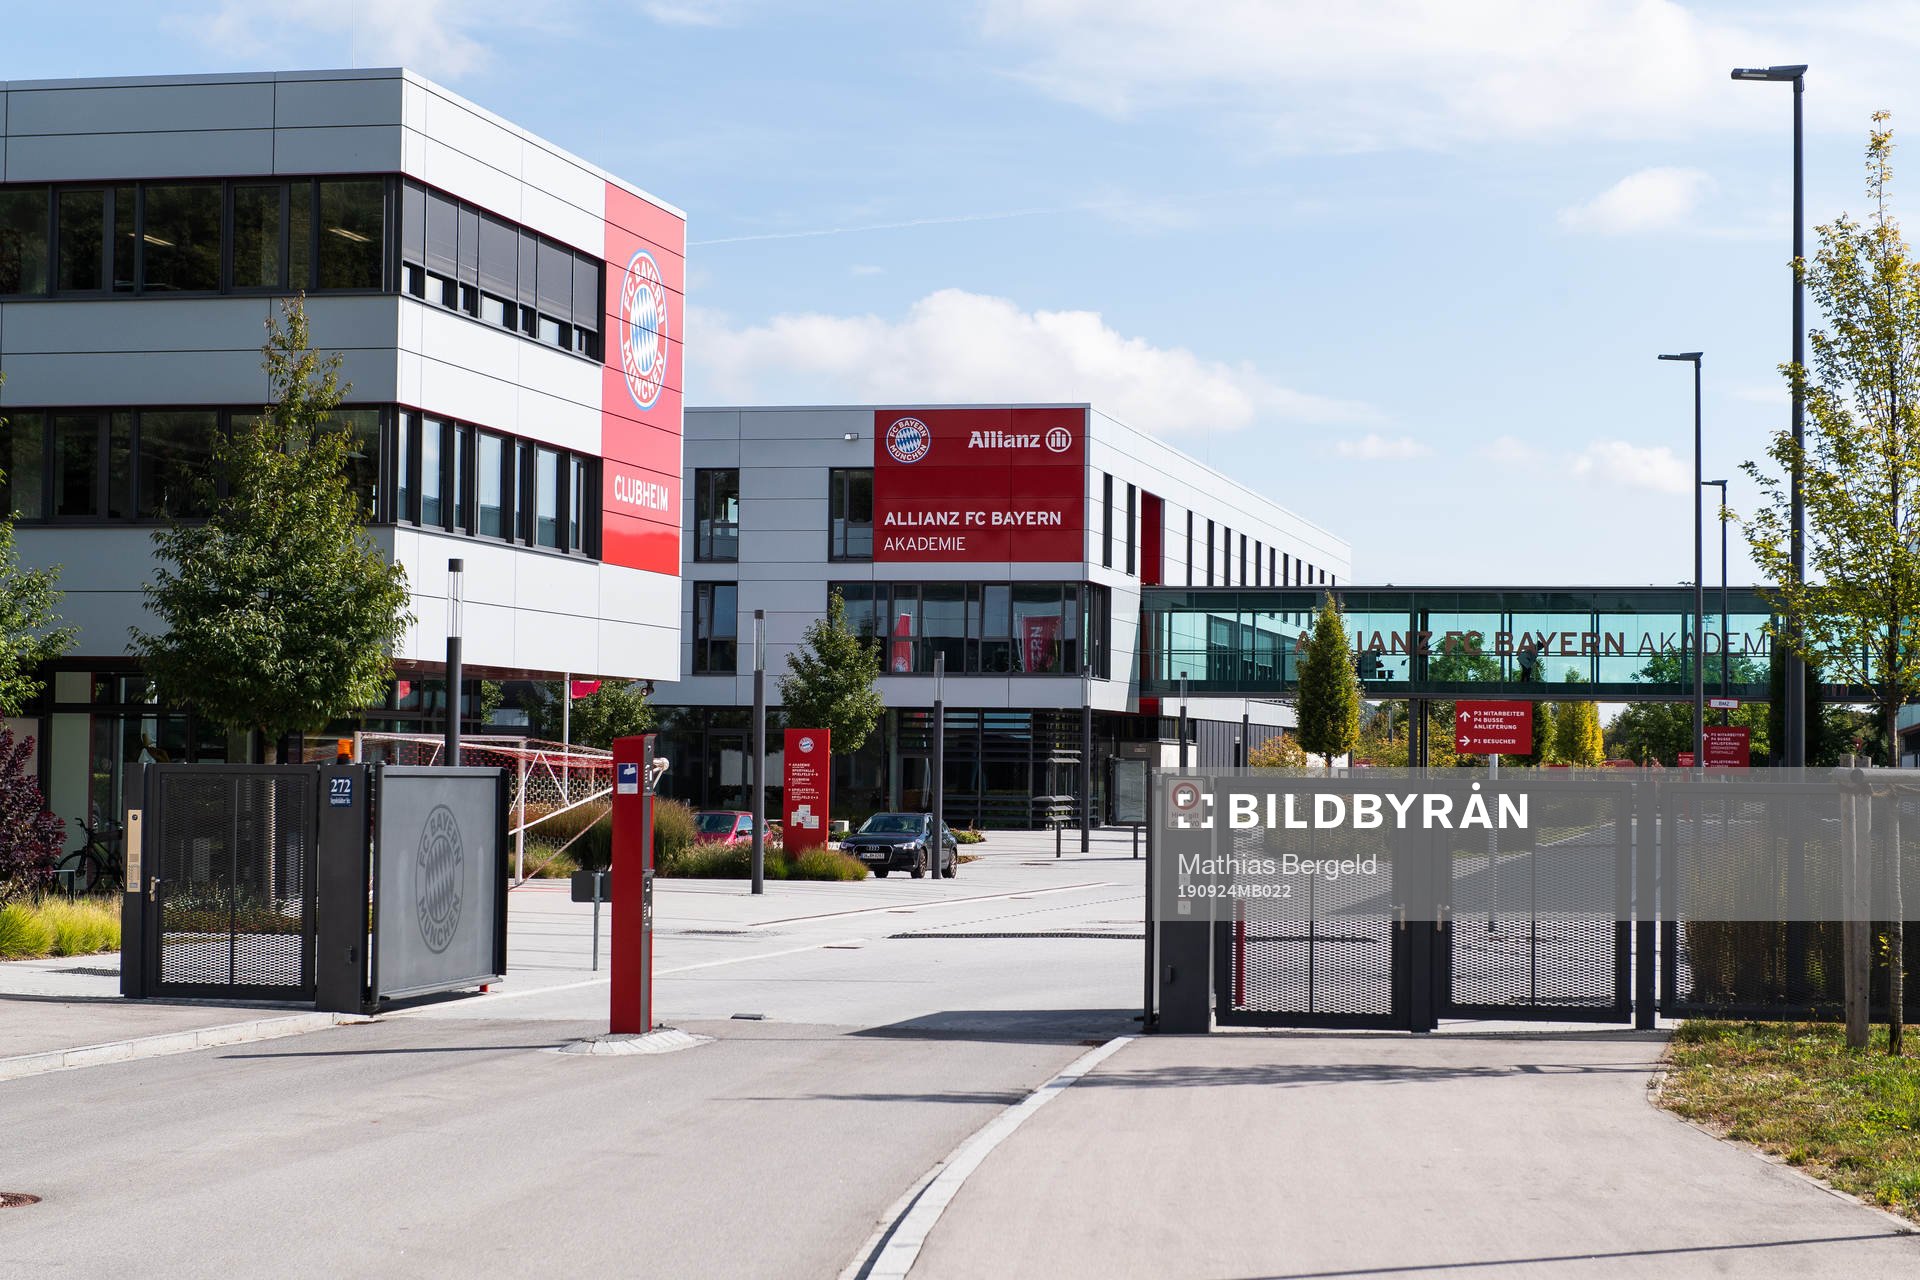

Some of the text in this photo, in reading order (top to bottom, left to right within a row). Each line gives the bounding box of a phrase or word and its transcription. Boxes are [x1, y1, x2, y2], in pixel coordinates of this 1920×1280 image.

[624, 261, 665, 325] FC BAYERN
[890, 420, 927, 437] FC BAYERN
[968, 431, 1040, 448] Allianz
[614, 474, 668, 512] CLUBHEIM
[884, 512, 1061, 525] ALLIANZ FC BAYERN
[884, 537, 966, 551] AKADEMIE
[1294, 631, 1767, 657] AIANZ FC BAYERN AKADEM
[330, 779, 351, 793] 272
[419, 811, 462, 868] FC BAYERN
